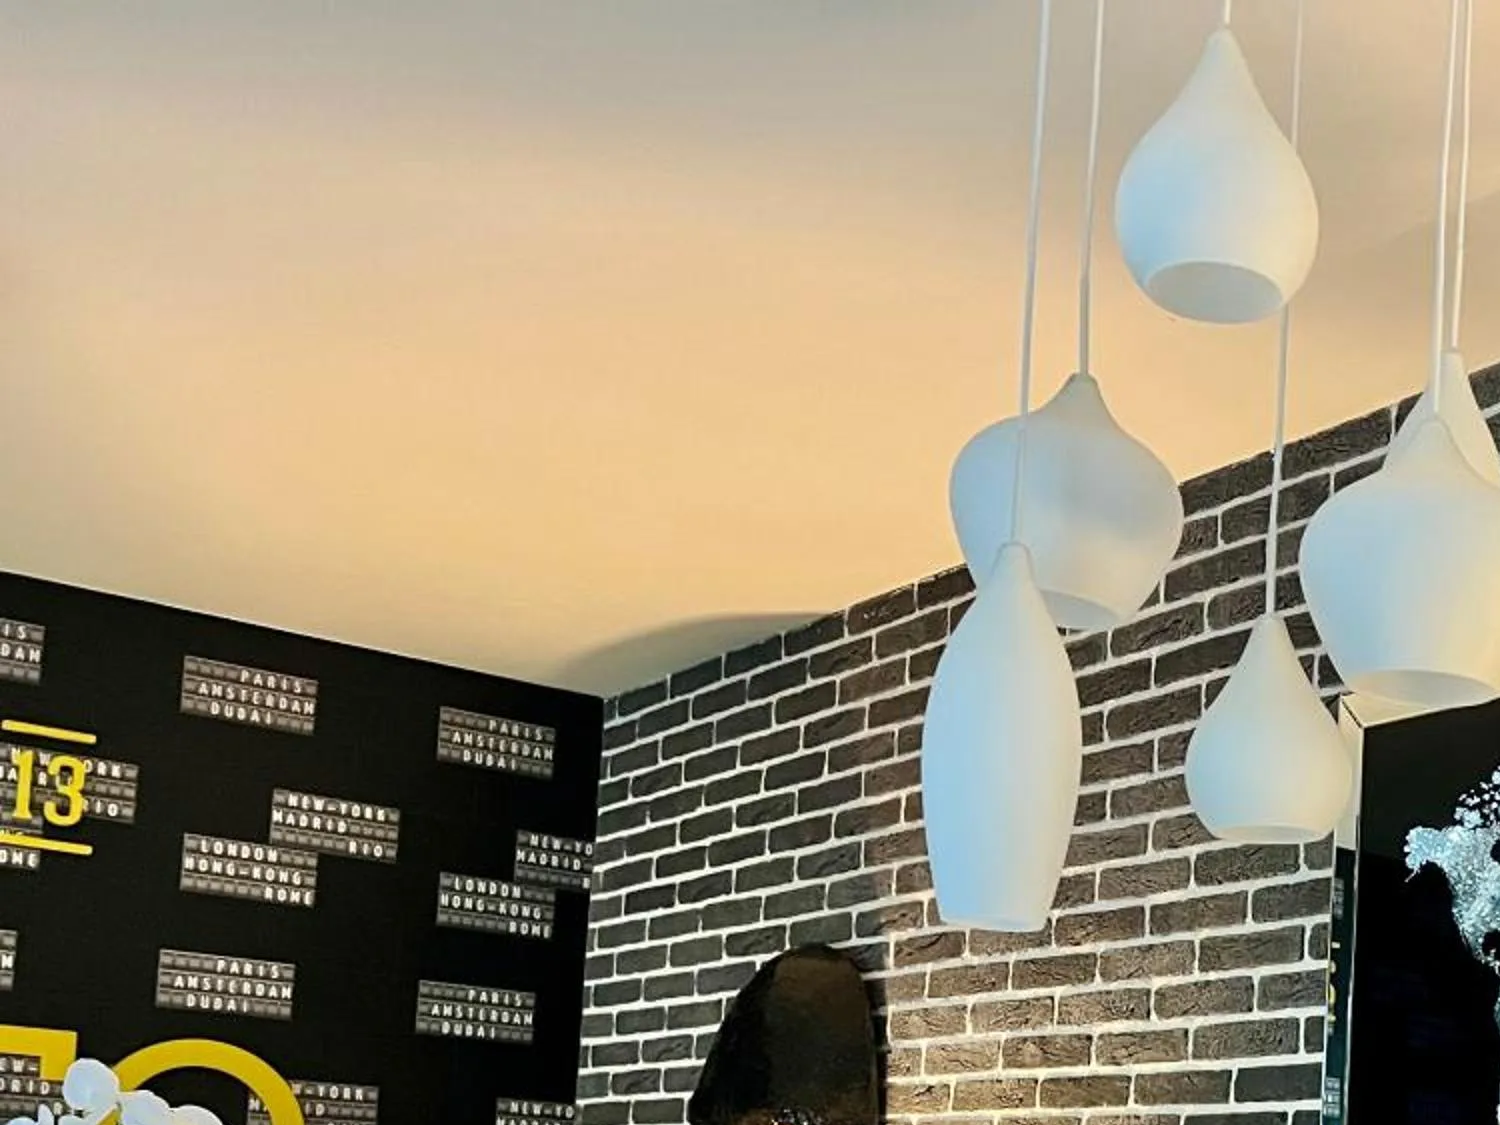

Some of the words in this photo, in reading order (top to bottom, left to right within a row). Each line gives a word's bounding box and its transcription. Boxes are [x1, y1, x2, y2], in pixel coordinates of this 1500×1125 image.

[241, 669, 301, 693] PARIS
[198, 682, 315, 715] AMSTERDAM
[210, 701, 271, 725] DUBAI
[12, 749, 85, 827] 13
[288, 793, 385, 821] NEW-YORK
[272, 809, 348, 834] MADRID
[200, 839, 278, 863] LONDON
[349, 841, 383, 858] RIO
[516, 849, 581, 871] MADRID
[185, 856, 301, 885] HONG-KONG
[264, 886, 313, 905] ROME
[454, 876, 521, 899] LONDON
[441, 893, 541, 920] HONG-KONG
[216, 959, 279, 979] PARIS
[173, 975, 292, 1000] AMSTERDAM
[186, 993, 248, 1013] DUBAI
